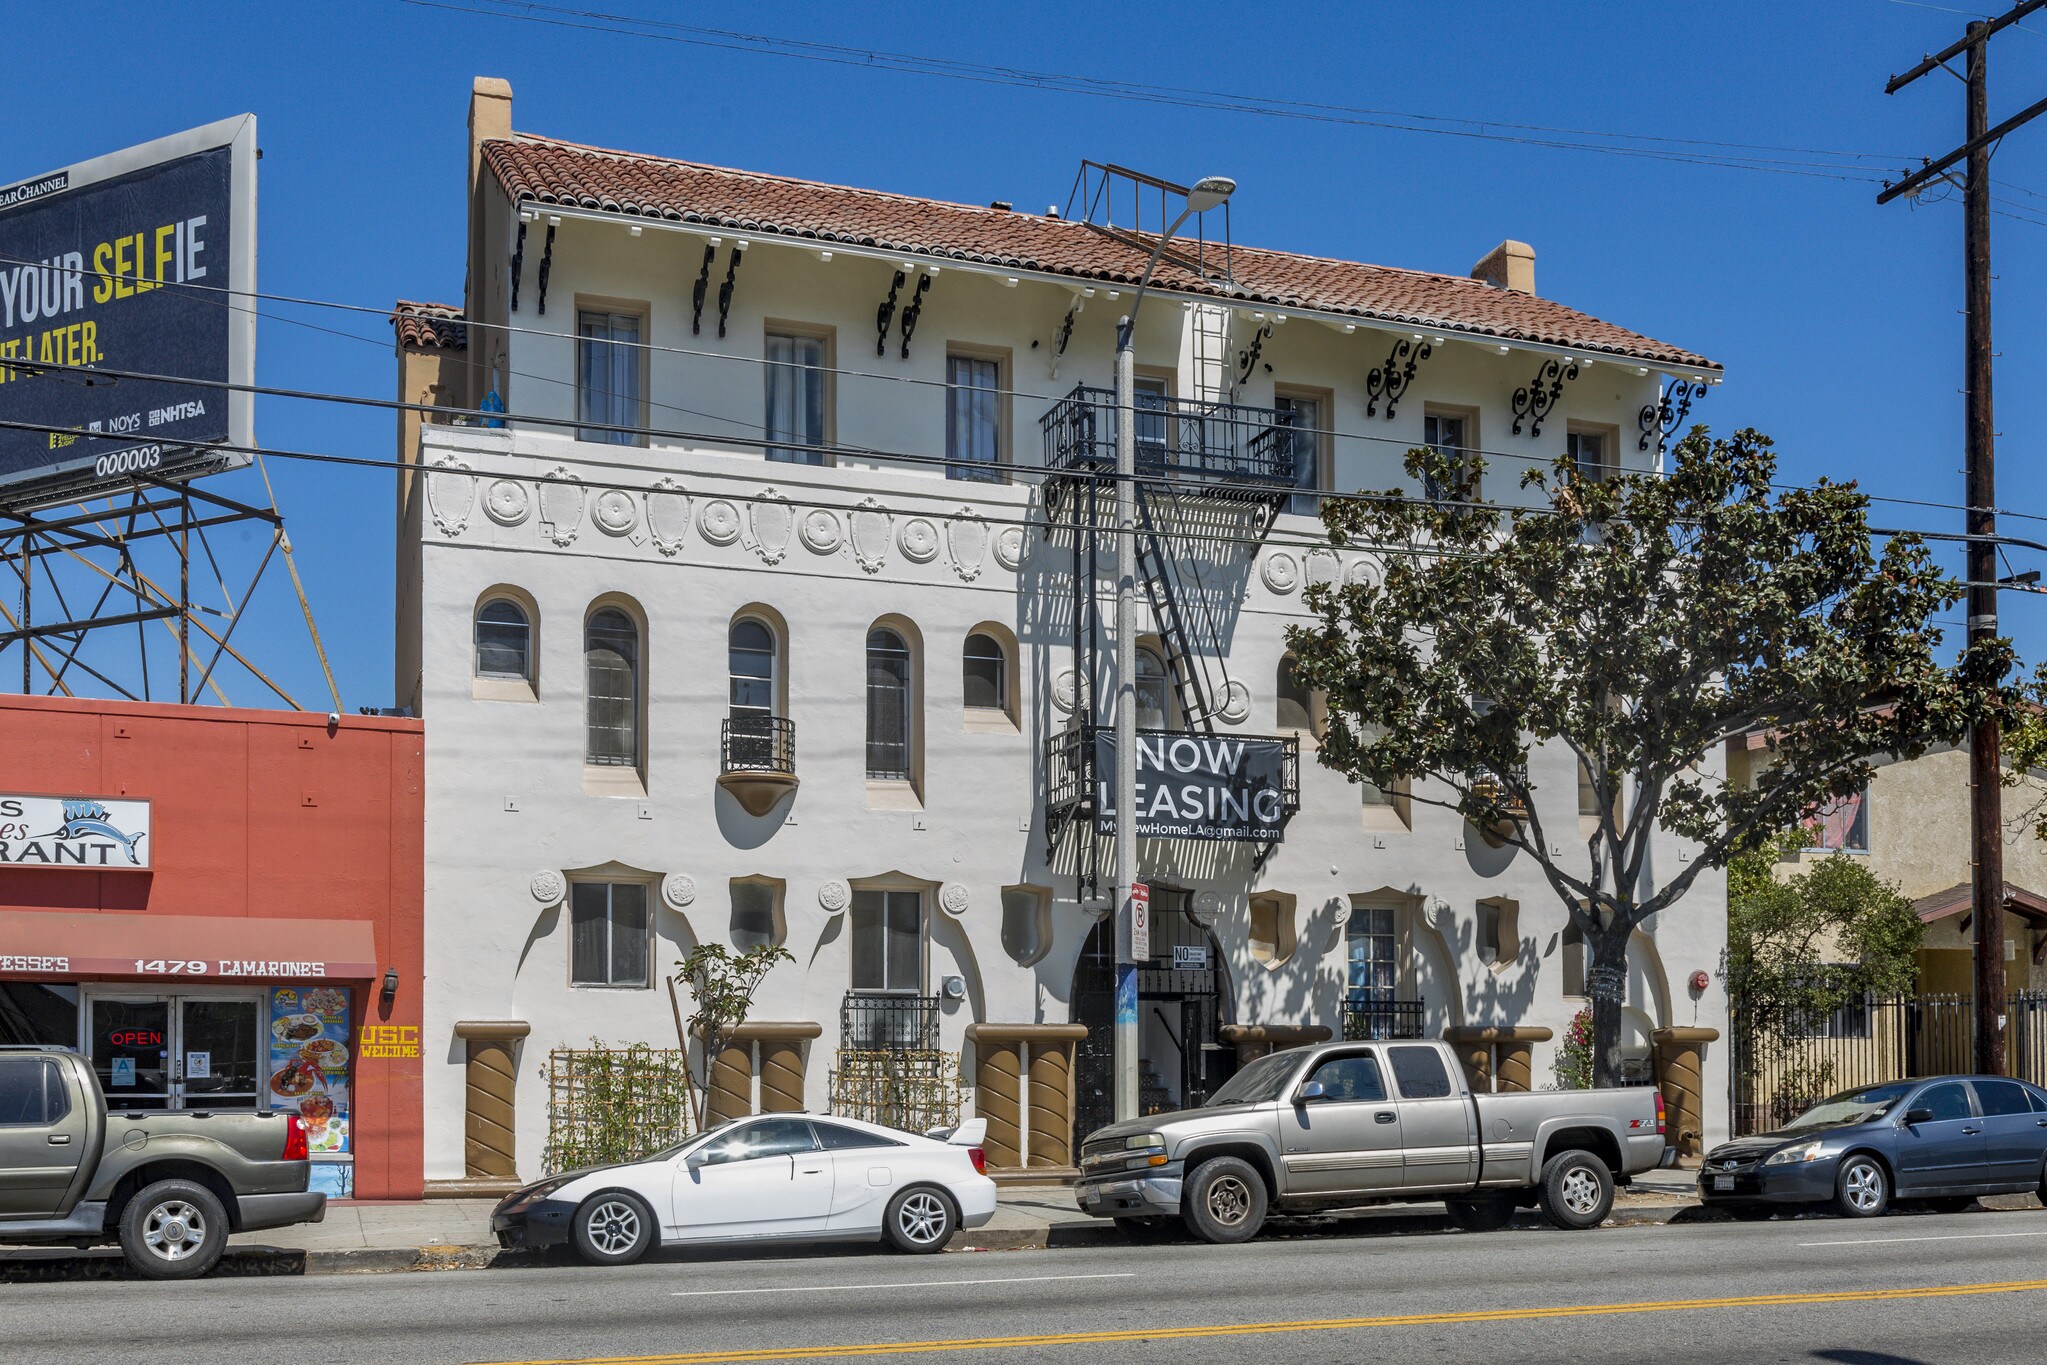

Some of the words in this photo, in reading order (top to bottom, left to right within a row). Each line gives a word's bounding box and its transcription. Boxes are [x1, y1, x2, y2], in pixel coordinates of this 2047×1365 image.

[0, 252, 84, 328] YOUR
[93, 215, 207, 304] SELFIE
[161, 400, 205, 423] NHTSA
[96, 445, 160, 477] 000003
[1136, 737, 1245, 775] NOW
[1100, 820, 1280, 838] MyewHomeLA@gmail.com
[1175, 947, 1189, 961] NO
[0, 956, 69, 972] ESSE'S
[135, 959, 207, 975] 1479
[218, 961, 326, 977] CAMARONES
[111, 1032, 161, 1045] OPEN
[357, 1025, 418, 1045] USC
[361, 1045, 420, 1058] WELCOME
[117, 1058, 130, 1073] A
[1629, 1119, 1655, 1128] Z71
